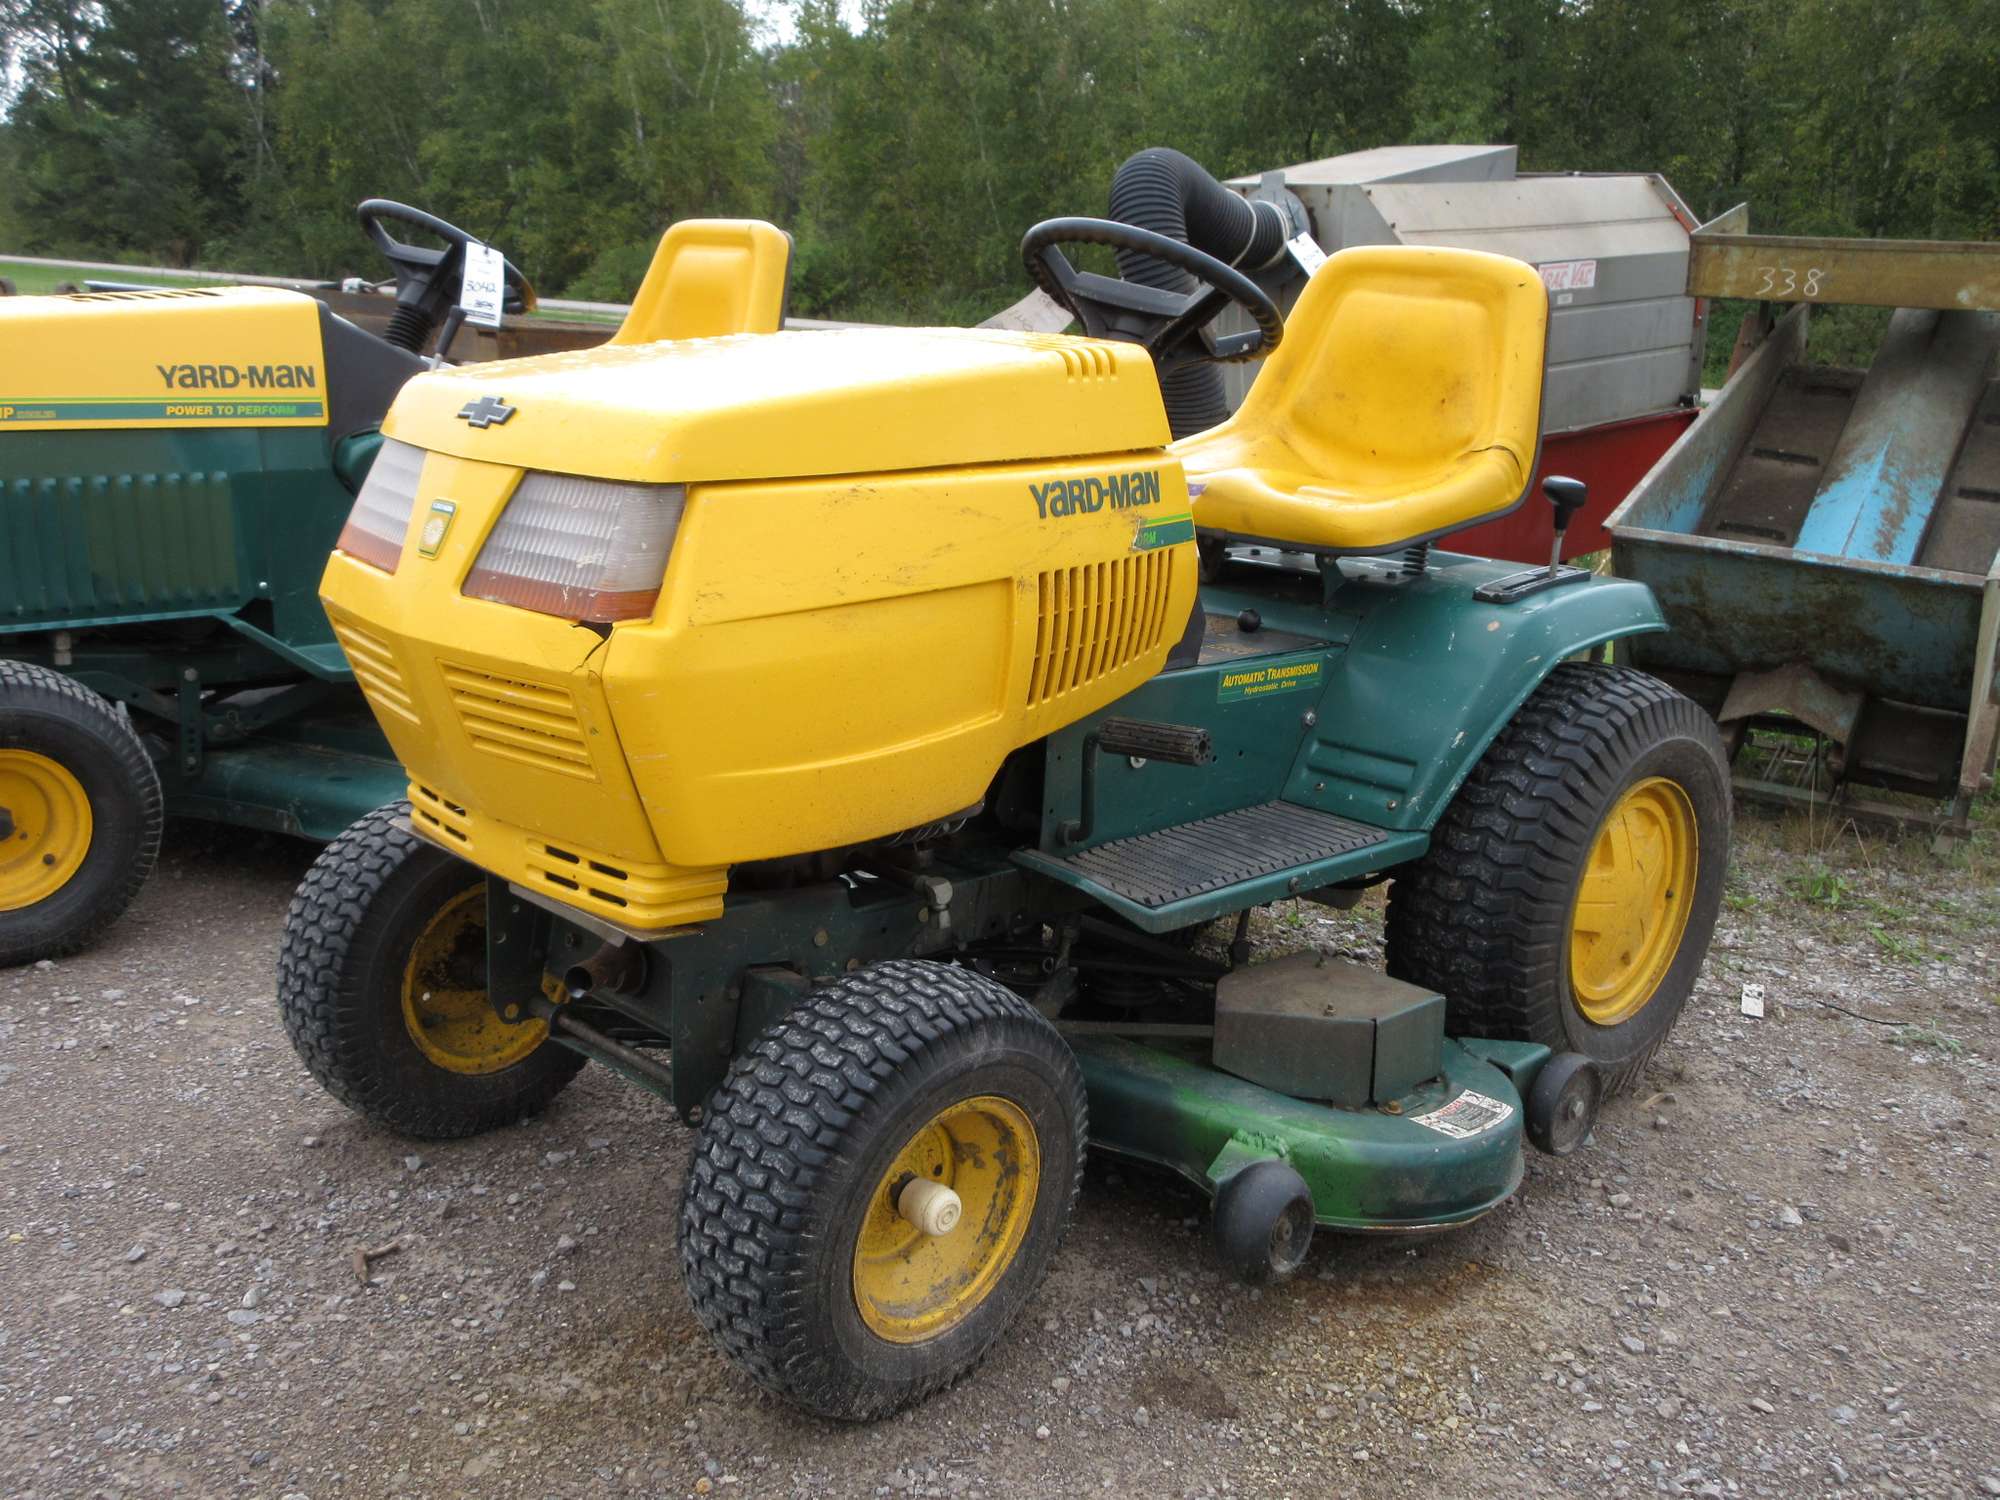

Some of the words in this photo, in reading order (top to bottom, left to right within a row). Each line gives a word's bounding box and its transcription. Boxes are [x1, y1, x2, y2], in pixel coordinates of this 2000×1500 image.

[1755, 266, 1824, 297] 338
[166, 405, 213, 416] POWER
[217, 405, 234, 416] TO
[237, 405, 297, 416] PERFORM
[1223, 671, 1265, 687] AUTOMATIC
[1267, 663, 1319, 681] TRANSMISSION
[1244, 682, 1279, 696] Hydrostatic
[1281, 680, 1297, 689] Drive
